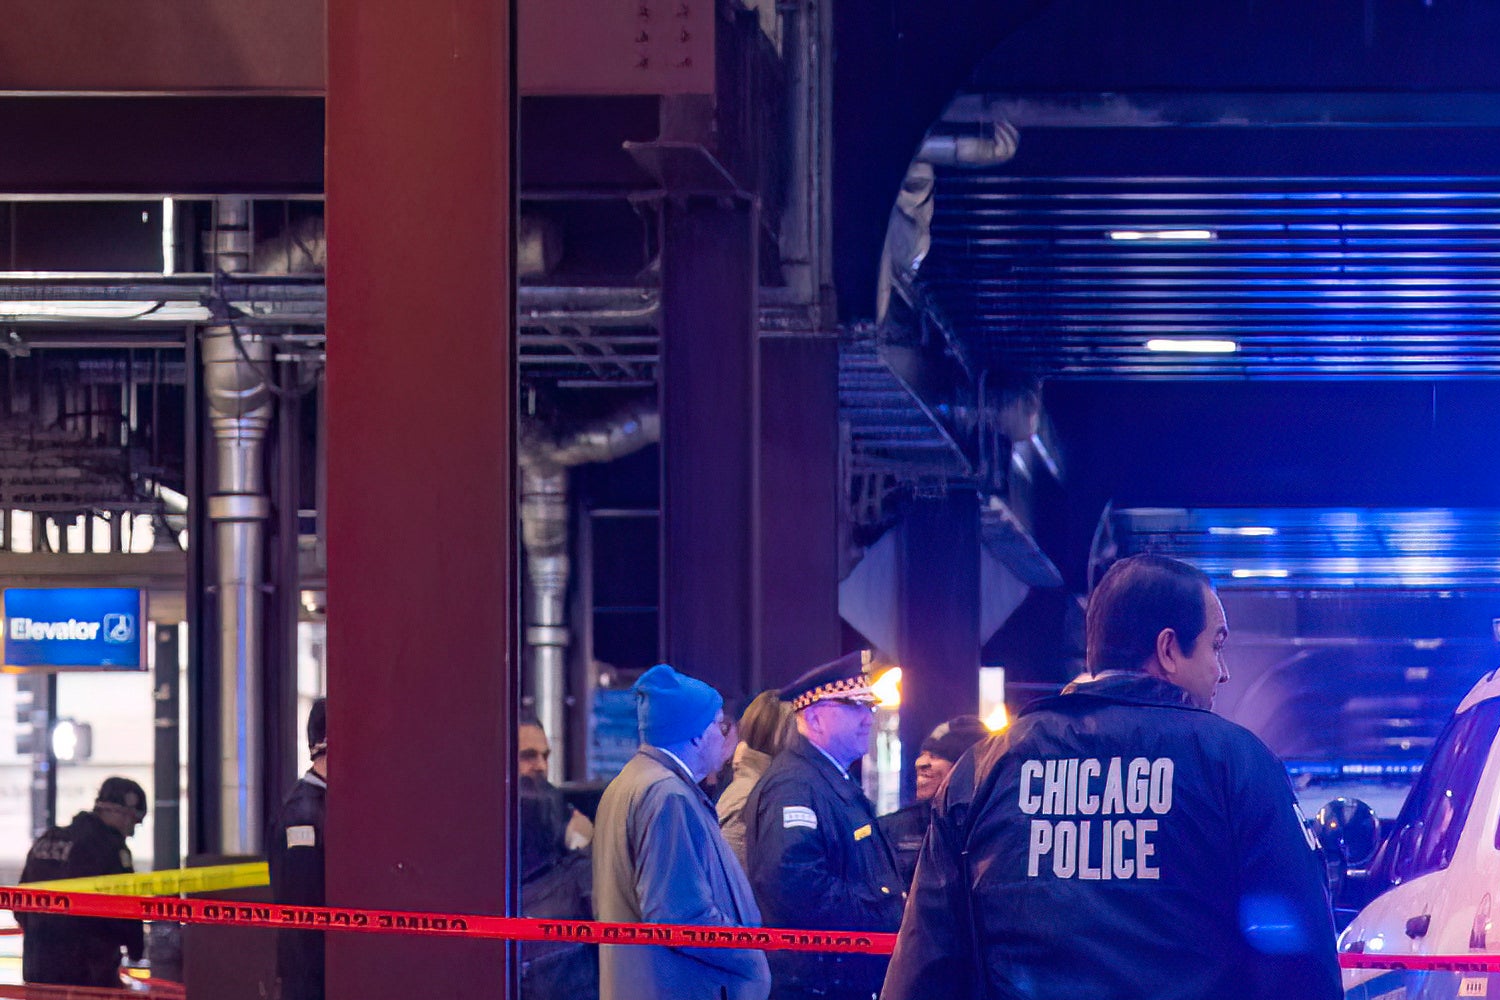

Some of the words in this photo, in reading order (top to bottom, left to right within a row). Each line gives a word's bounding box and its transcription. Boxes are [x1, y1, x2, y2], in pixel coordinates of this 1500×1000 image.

[10, 617, 100, 640] Elevator
[1018, 757, 1175, 815] CHICAGO
[1028, 818, 1160, 880] POLICE
